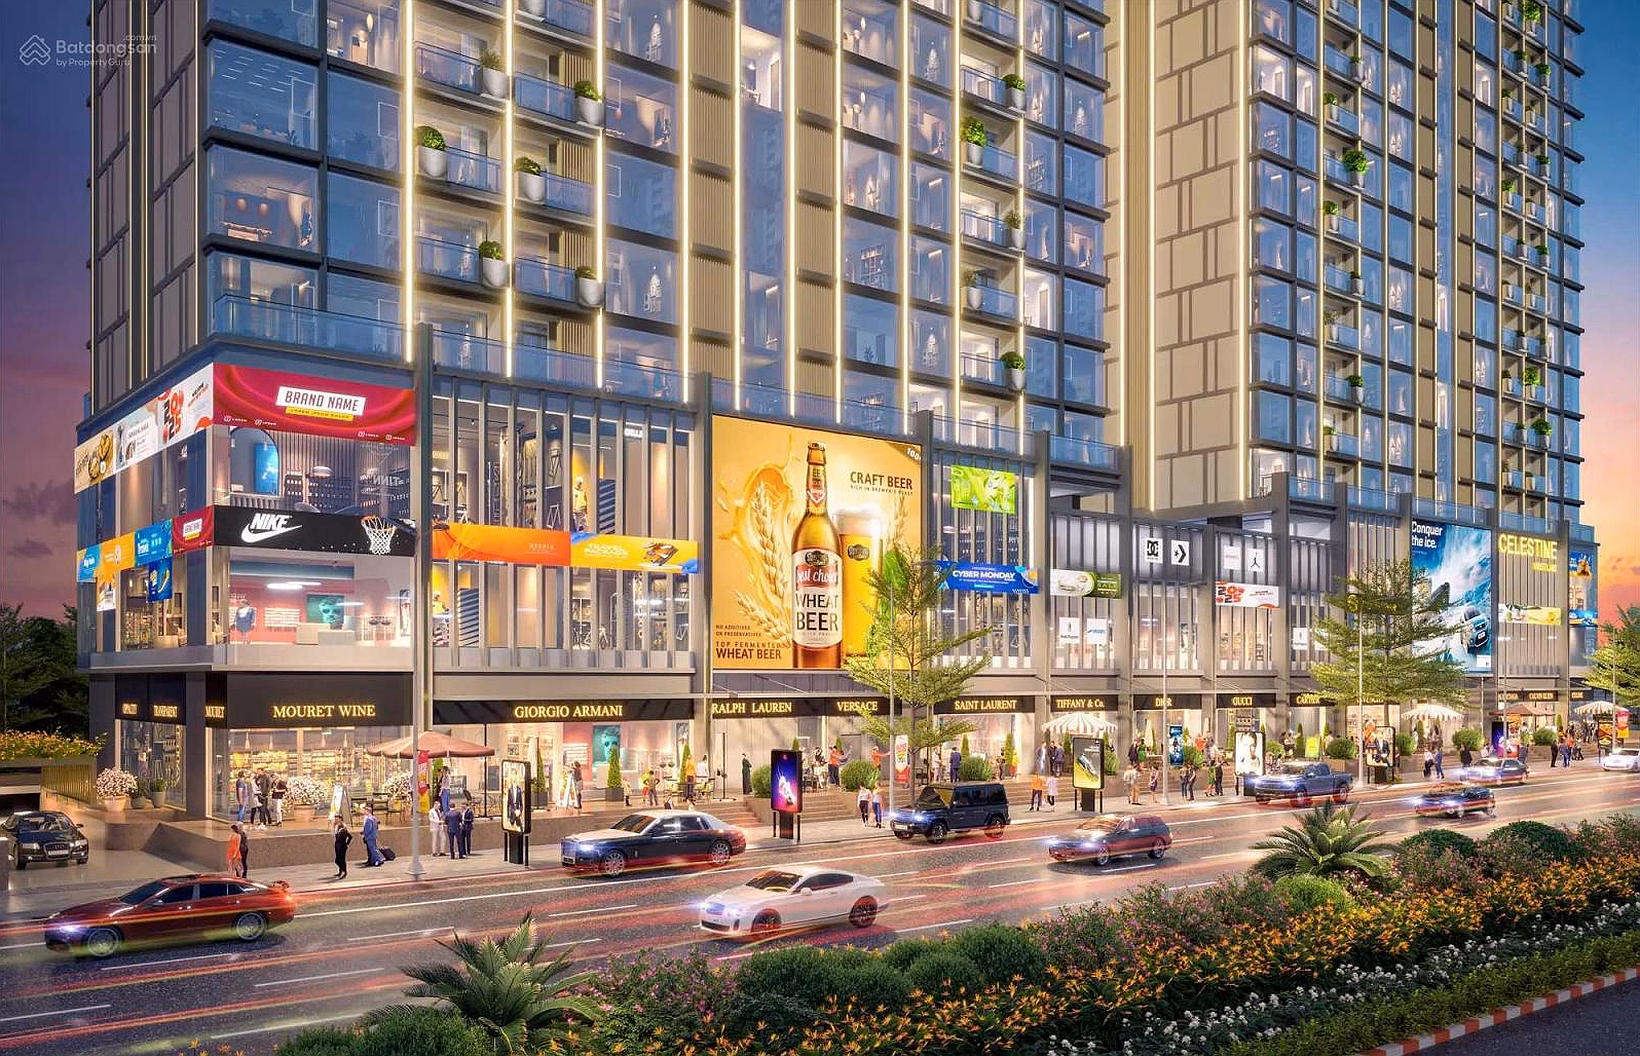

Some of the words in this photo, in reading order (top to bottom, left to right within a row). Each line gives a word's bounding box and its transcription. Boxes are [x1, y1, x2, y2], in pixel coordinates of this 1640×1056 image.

[285, 391, 324, 407] BRAND
[327, 397, 360, 412] NAME
[850, 471, 885, 486] CRAFT
[887, 475, 913, 490] BEER
[250, 512, 289, 530] NIKE
[1412, 521, 1443, 537] Conquer
[1412, 534, 1423, 547] the
[1424, 536, 1437, 548] ice.
[1498, 533, 1558, 560] CELESTINE
[952, 570, 979, 579] CYBER
[981, 571, 1016, 580] MONDAY
[795, 593, 839, 608] WHEAT
[796, 611, 839, 632] BEER
[716, 647, 753, 659] WHEAT
[756, 648, 782, 660] BEER
[711, 702, 746, 714] RALPH
[752, 702, 792, 713] LAUREN
[836, 701, 878, 712] VERSACE
[954, 700, 979, 710] SAINT
[980, 700, 1018, 710] LAURENT
[1056, 699, 1086, 708] TIFFANY
[1087, 699, 1094, 708] &
[1231, 696, 1253, 706] GUCCI
[272, 705, 335, 718] MOURET
[338, 704, 376, 717] WINE
[514, 705, 570, 718] GIORGIO
[572, 705, 623, 717] ARMANI
